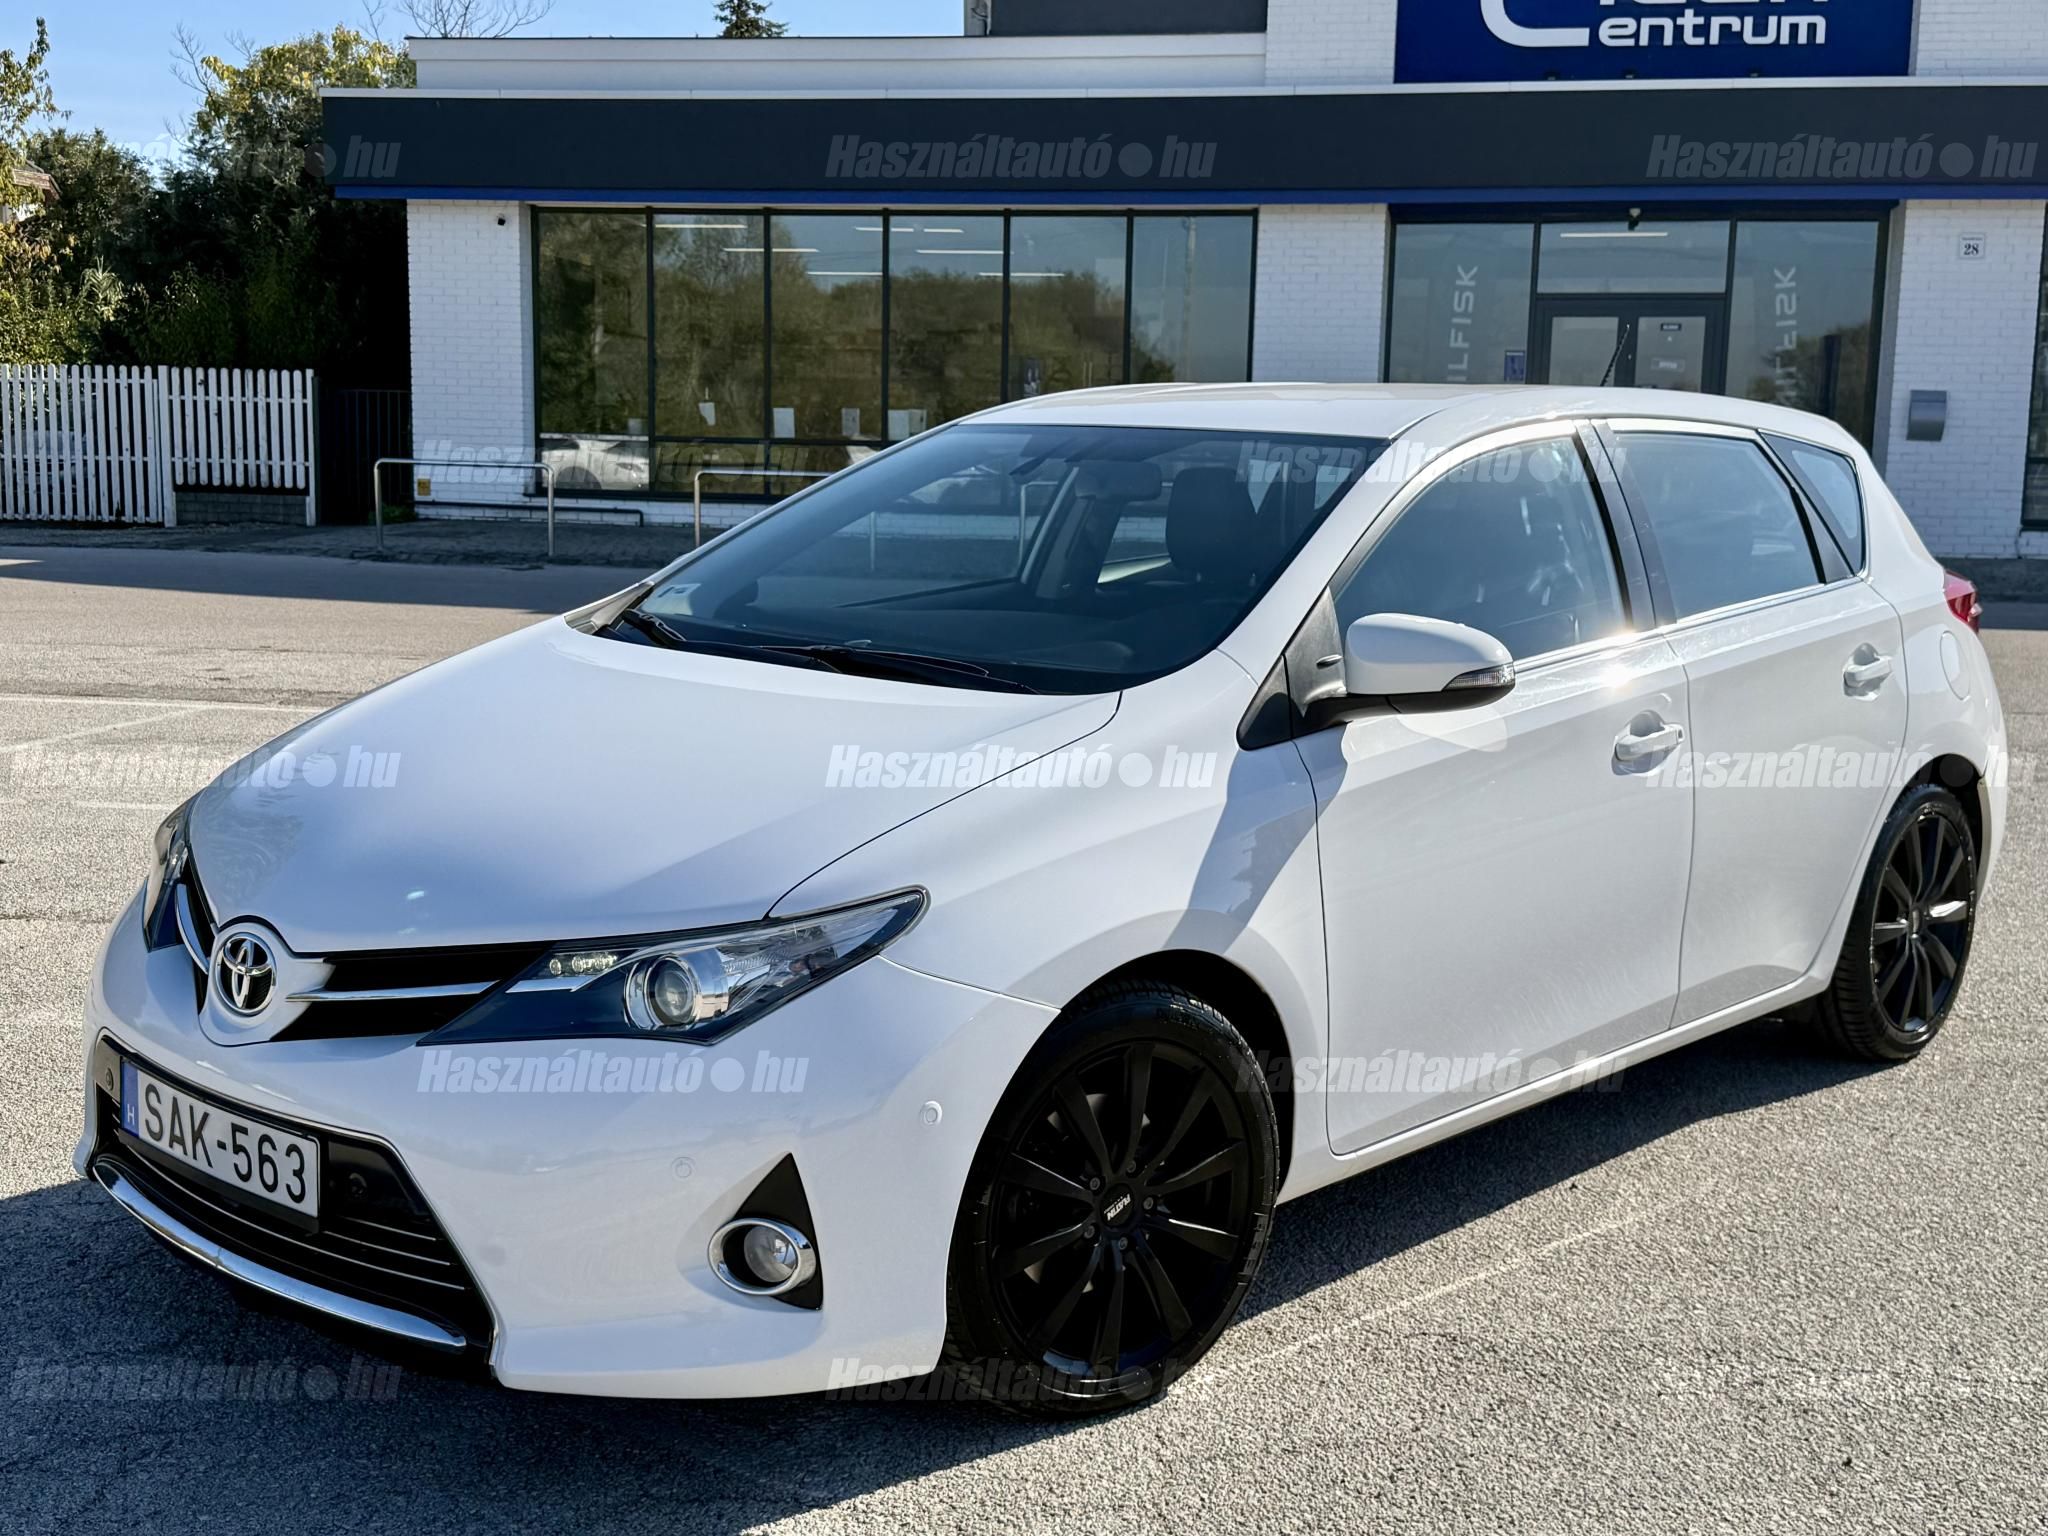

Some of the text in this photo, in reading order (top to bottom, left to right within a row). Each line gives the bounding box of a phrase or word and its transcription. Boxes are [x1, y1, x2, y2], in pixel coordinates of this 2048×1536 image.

[1963, 243, 1979, 256] 28
[126, 1105, 135, 1126] H
[144, 1083, 306, 1204] SAK-563
